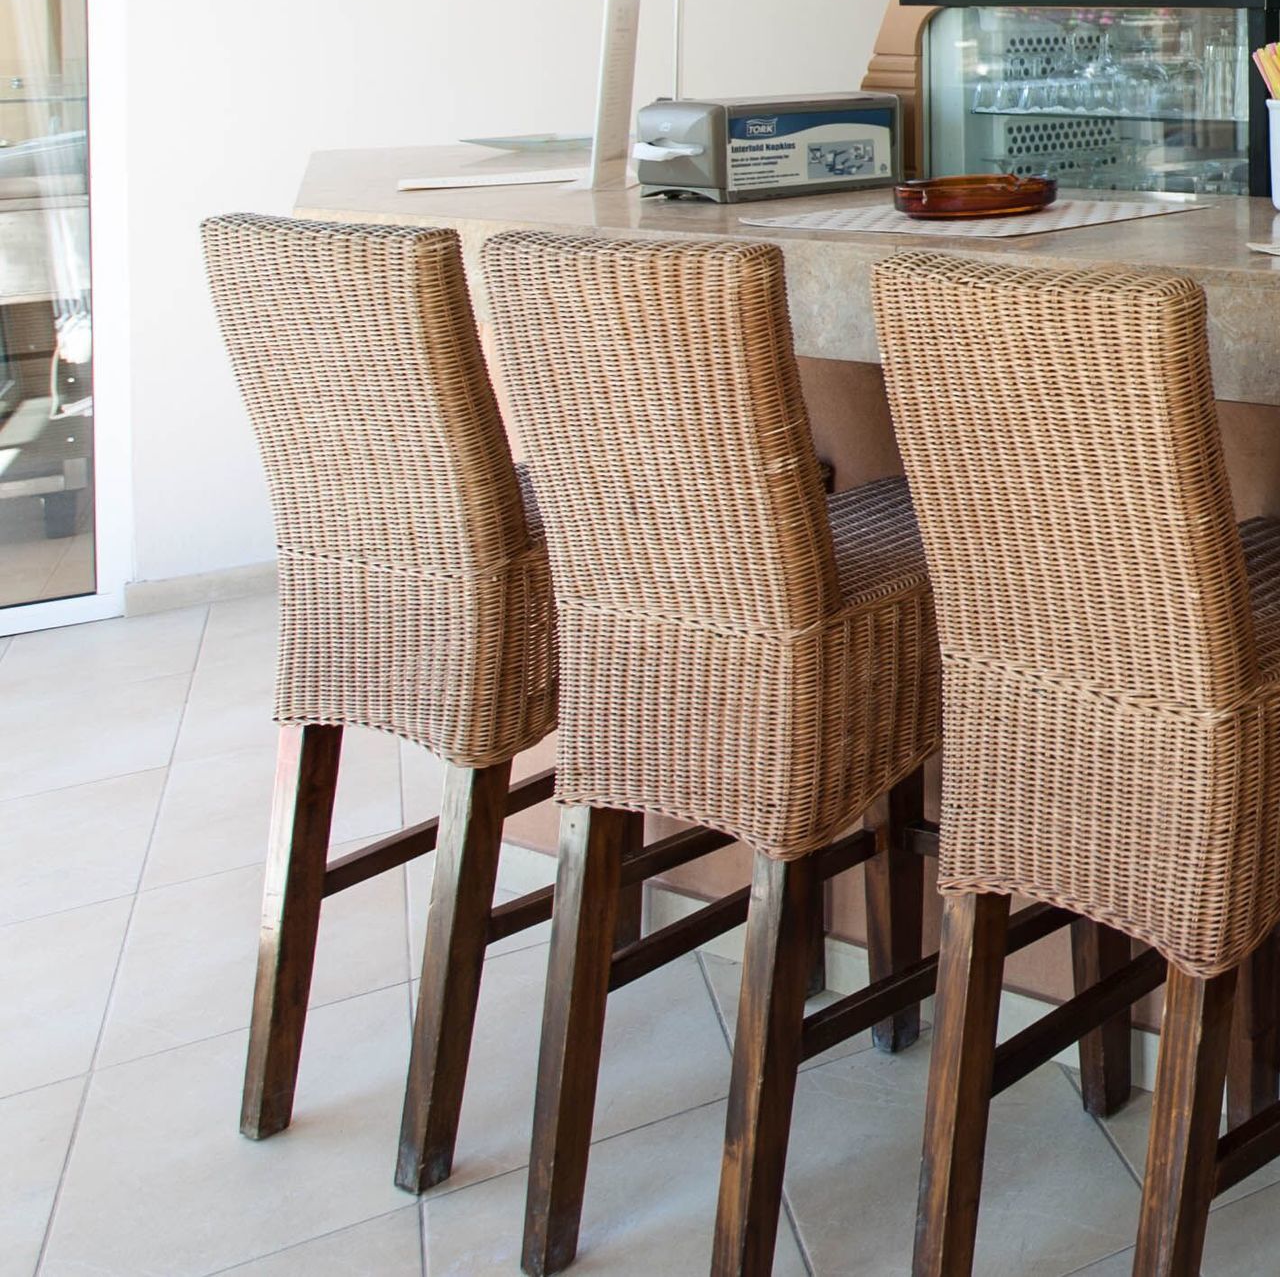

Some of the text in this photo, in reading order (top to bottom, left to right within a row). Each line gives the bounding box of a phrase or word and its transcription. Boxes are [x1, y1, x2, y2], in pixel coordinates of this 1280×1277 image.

[748, 125, 773, 134] TORK
[731, 142, 796, 153] Interfold Napkins
